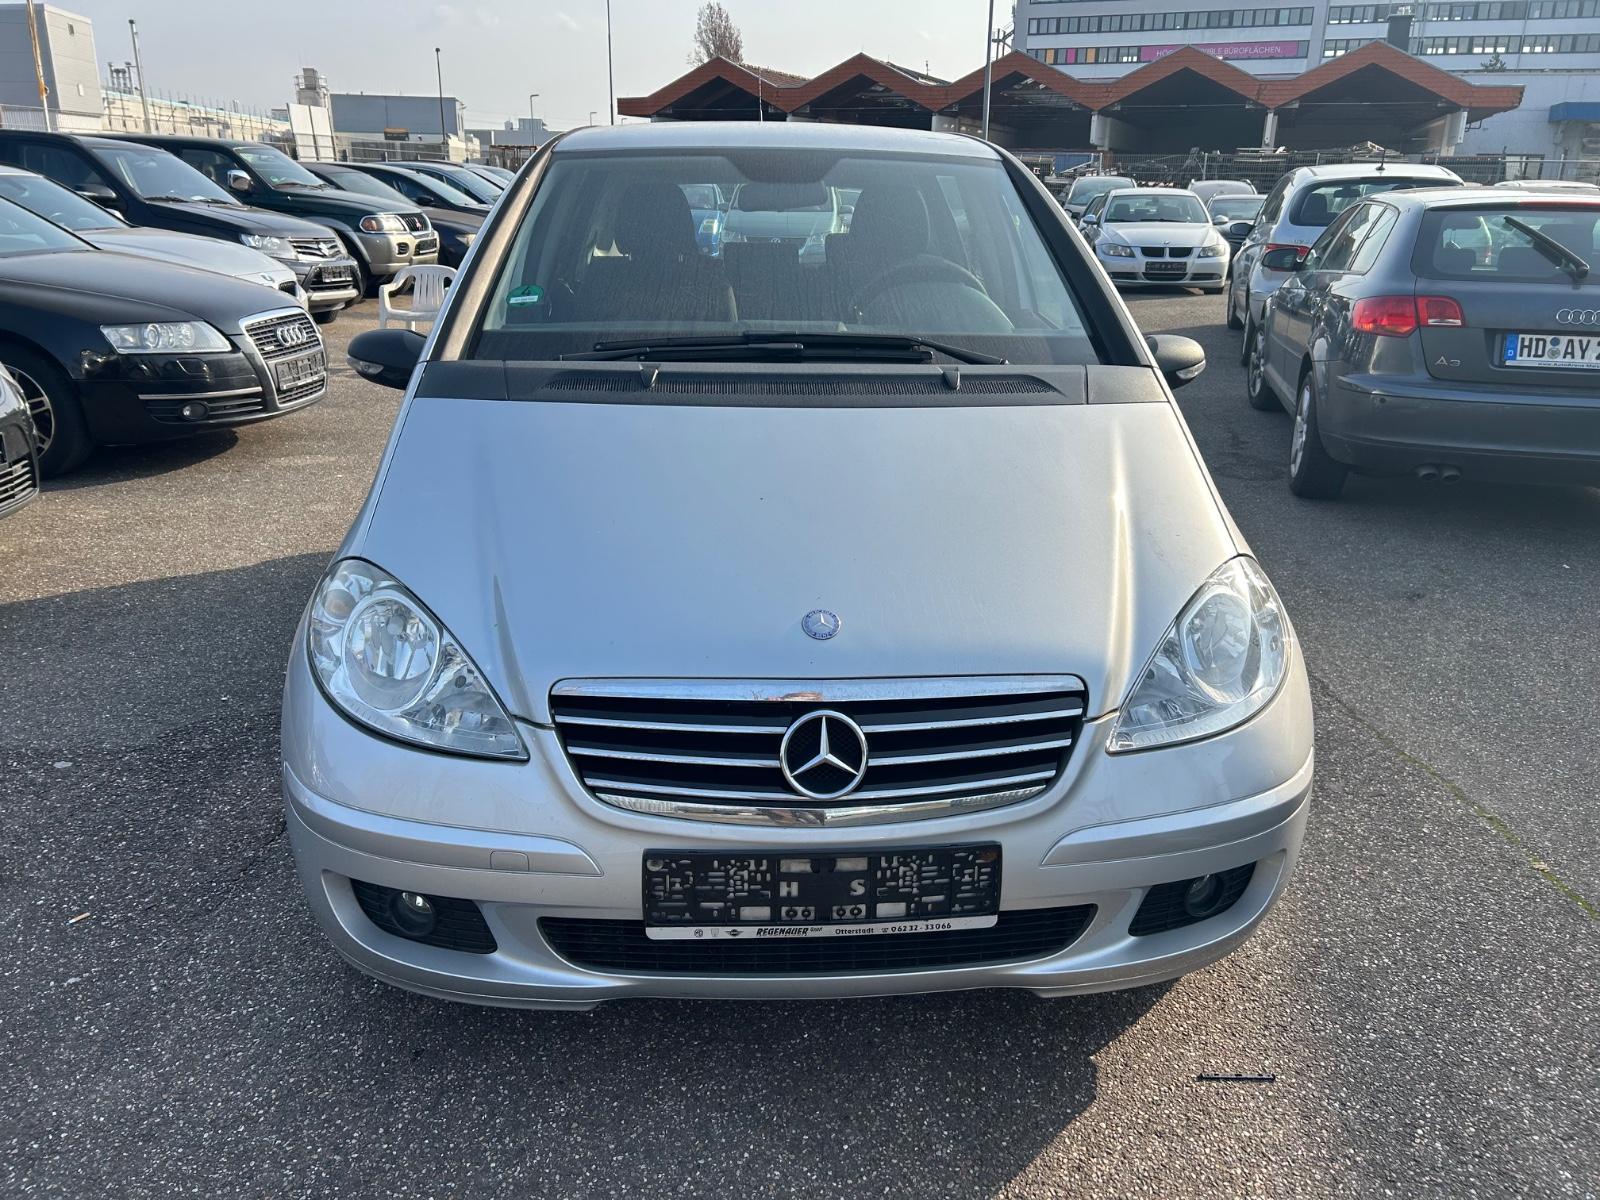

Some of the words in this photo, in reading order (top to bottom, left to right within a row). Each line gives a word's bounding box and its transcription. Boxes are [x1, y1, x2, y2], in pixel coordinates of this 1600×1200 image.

[1518, 337, 1547, 358] HD
[1562, 338, 1591, 360] AY
[756, 927, 809, 937] REGENAUER
[835, 927, 874, 935] Otterstadt
